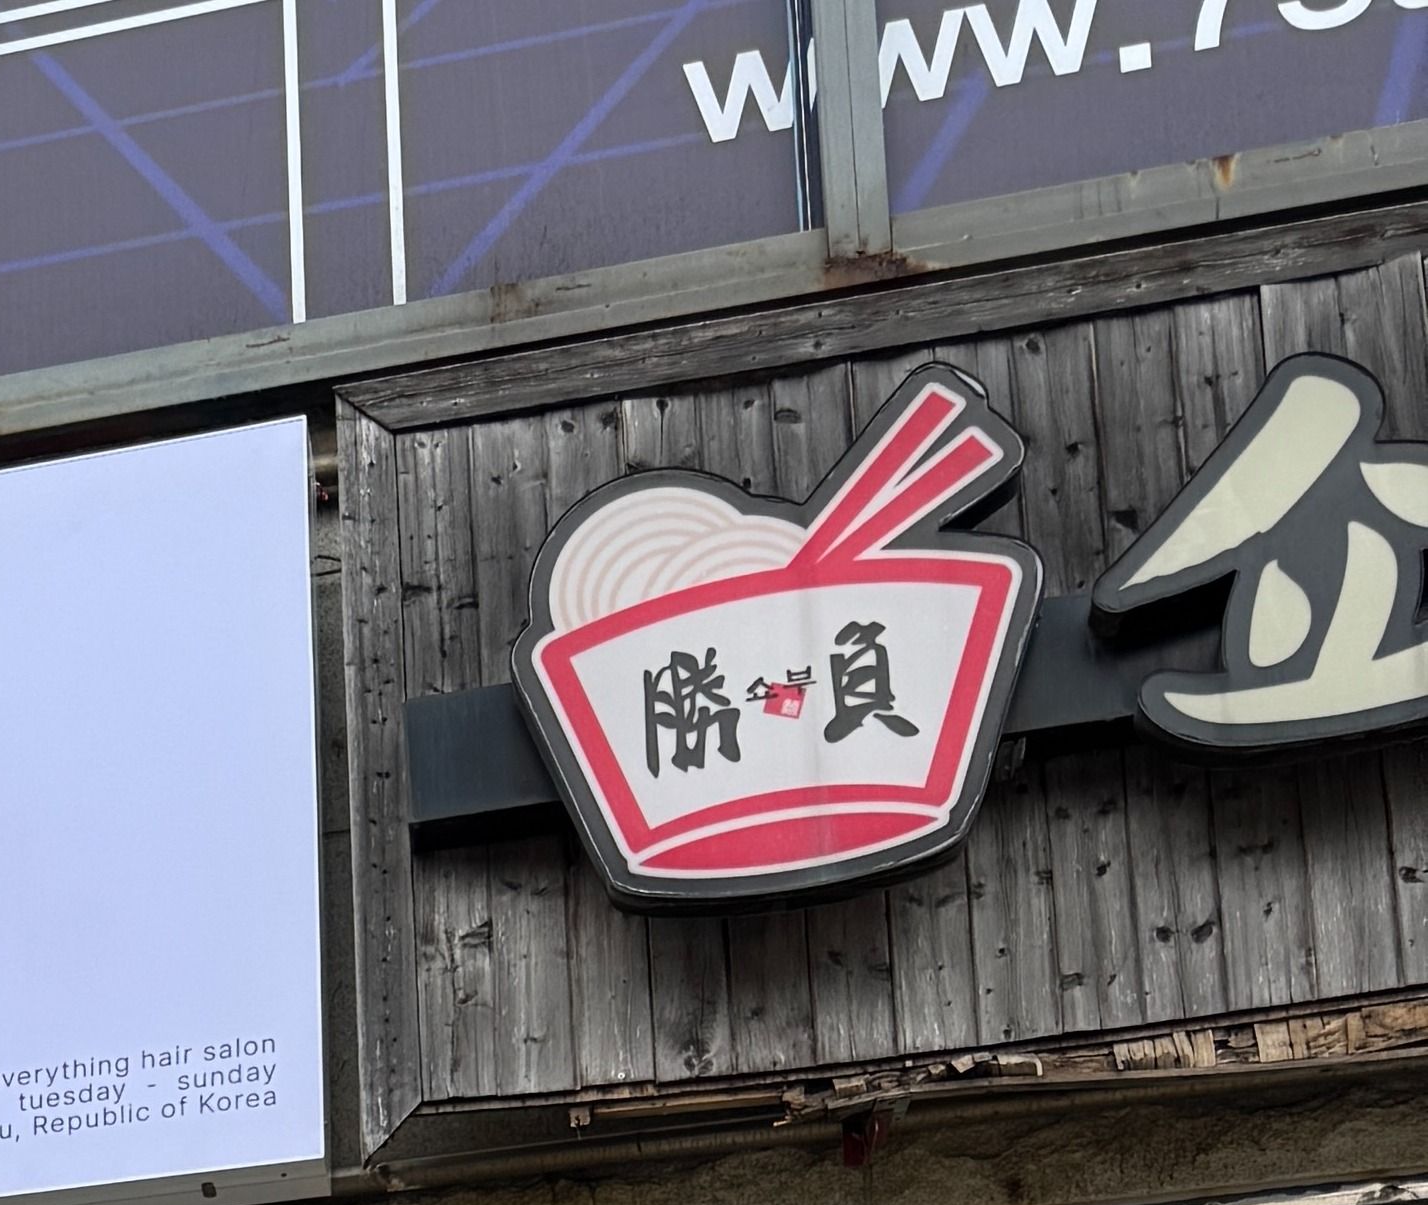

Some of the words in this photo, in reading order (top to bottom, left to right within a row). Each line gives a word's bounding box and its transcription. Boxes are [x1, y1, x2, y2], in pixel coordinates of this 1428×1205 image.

[142, 1044, 193, 1069] hair
[203, 1037, 276, 1062] salon
[19, 1080, 125, 1112] tuesday
[177, 1062, 277, 1092] sunday
[33, 1104, 150, 1136] Republic
[161, 1096, 188, 1119] of
[199, 1089, 277, 1114] Korea
